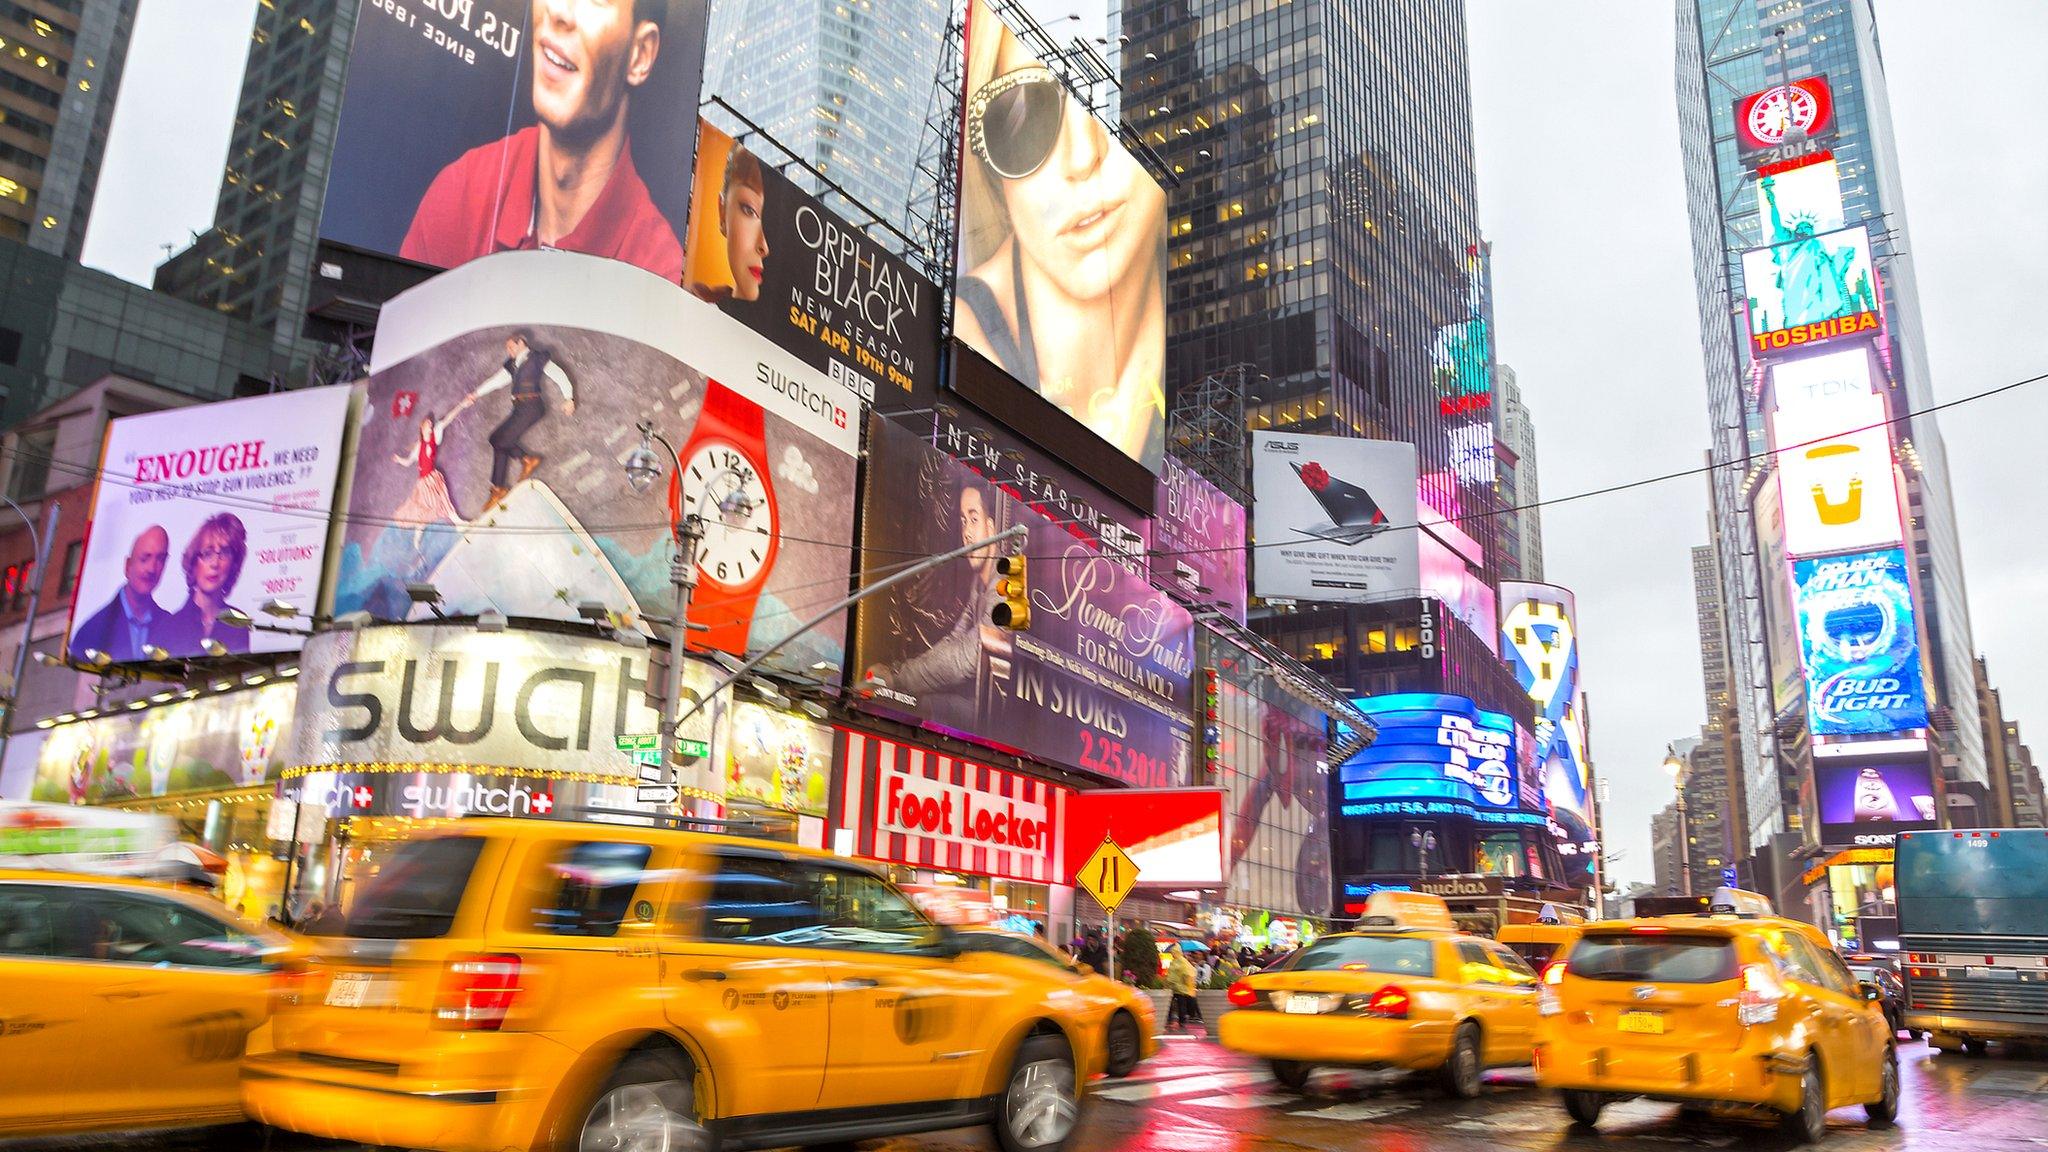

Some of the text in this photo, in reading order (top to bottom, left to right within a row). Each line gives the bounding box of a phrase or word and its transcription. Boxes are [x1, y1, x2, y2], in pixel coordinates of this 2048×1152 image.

[1769, 139, 1817, 162] 2014
[795, 205, 918, 317] ORPHAN
[815, 254, 903, 344] BLACK
[789, 305, 913, 393] SAT APR 19TH 9PM
[791, 286, 914, 375] NEW SEASON
[1754, 311, 1878, 351] TOSHIBA
[756, 361, 834, 422] swatch
[831, 360, 873, 400] BBC
[1803, 379, 1860, 399] TDK
[722, 451, 741, 473] 12
[1264, 440, 1299, 451] ASUS
[948, 423, 1098, 530] NEW SEASON
[1168, 487, 1211, 541] BLACK
[1420, 598, 1434, 660] 1500
[1077, 633, 1144, 688] FORMULA
[1016, 664, 1044, 707] IN
[1049, 680, 1128, 739] STORES
[1824, 693, 1910, 714] LIGHT
[1835, 678, 1900, 697] BUD
[1079, 729, 1168, 788] 2.25.2014
[401, 782, 531, 815] swatch
[887, 776, 1049, 851] Foot Locker
[1968, 839, 1989, 848] 1499
[1421, 880, 1489, 895] nuchas
[875, 998, 895, 1009] NYC
